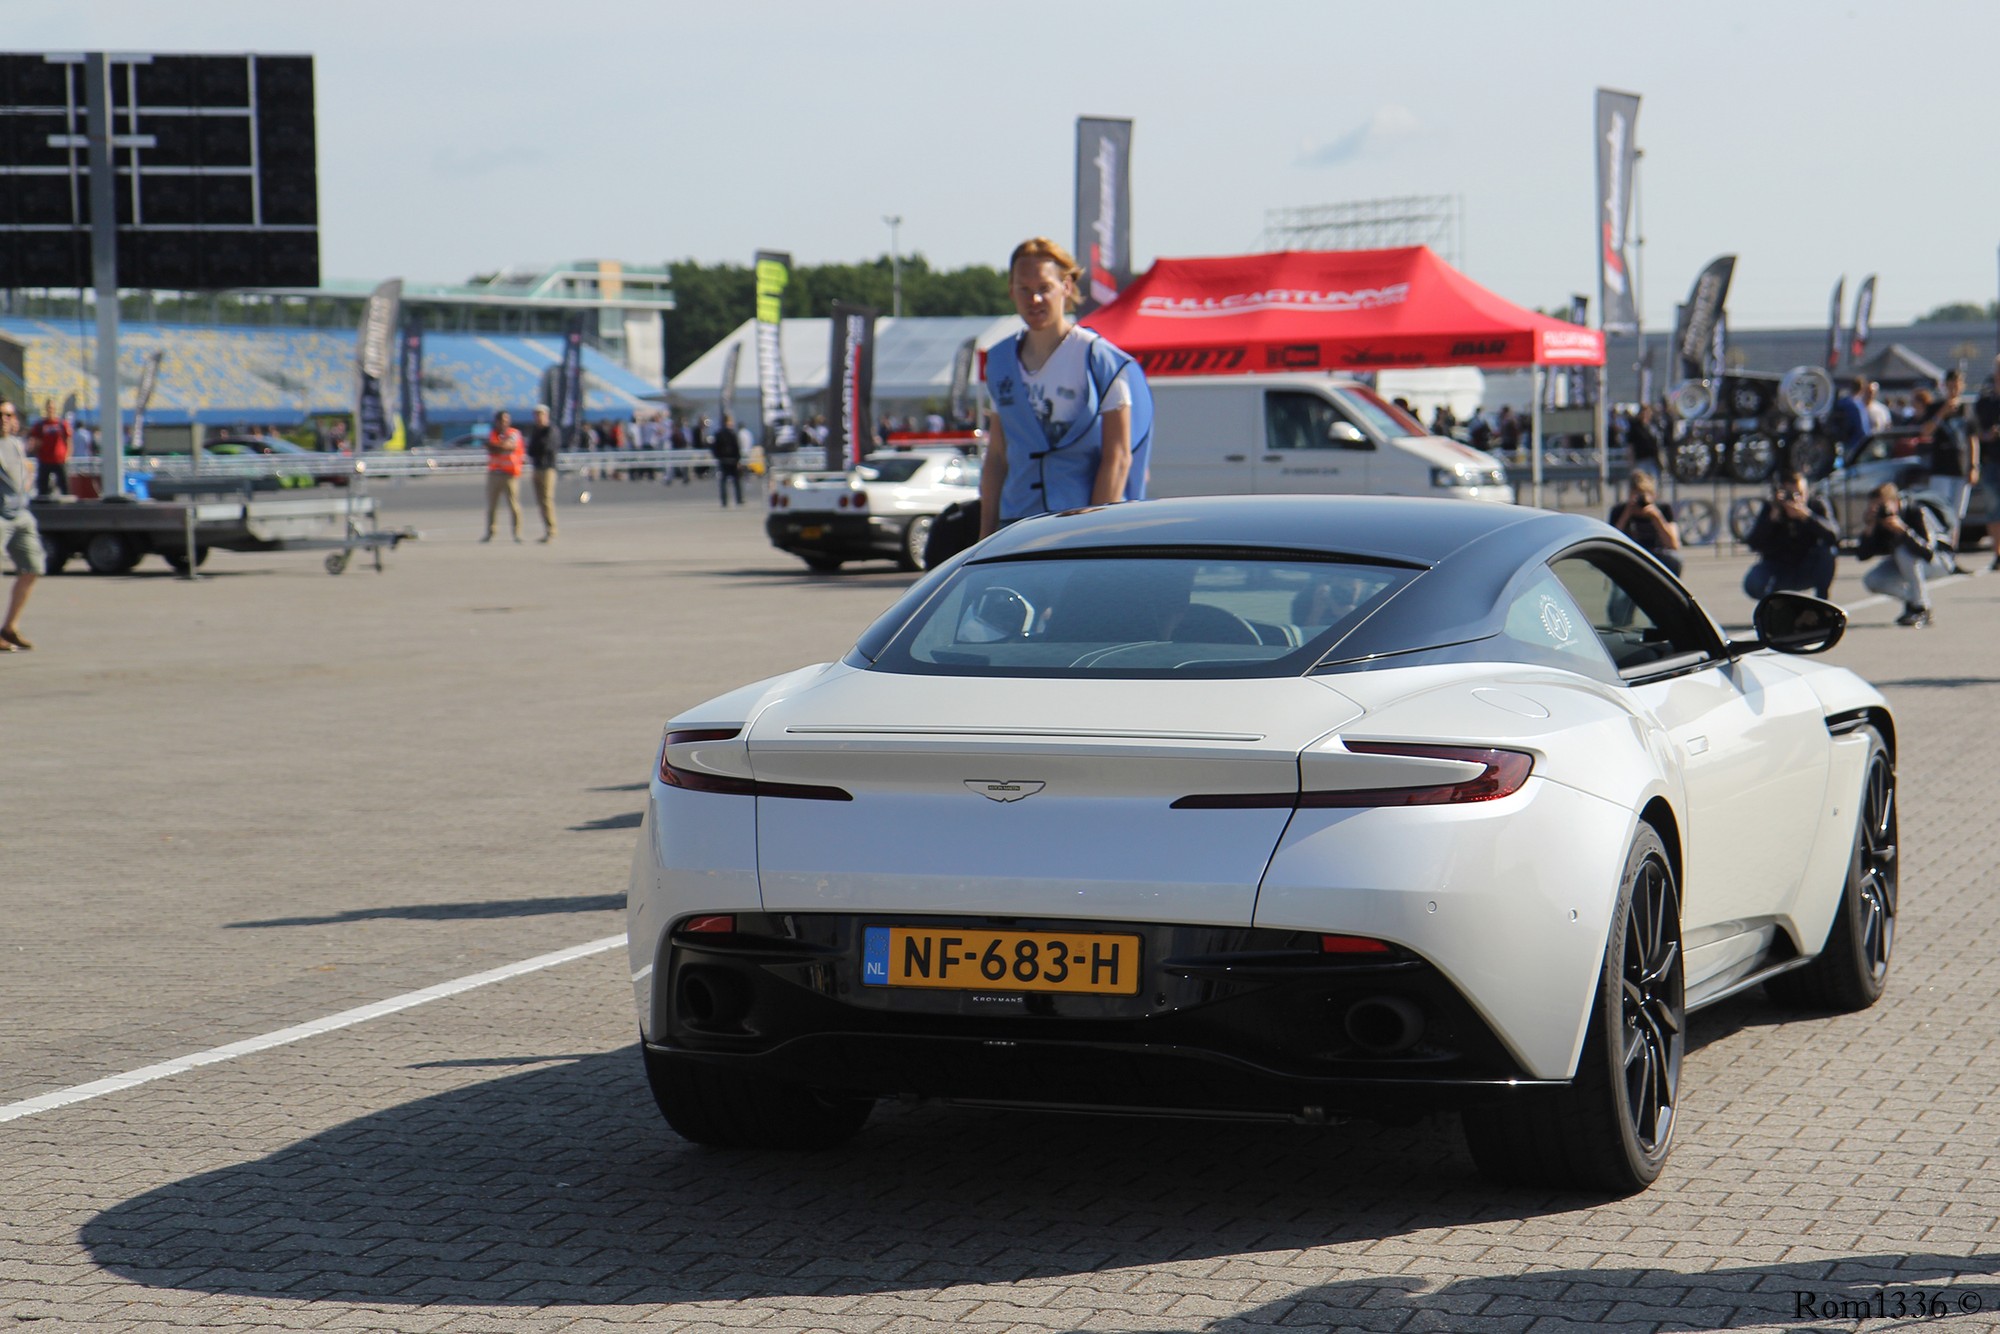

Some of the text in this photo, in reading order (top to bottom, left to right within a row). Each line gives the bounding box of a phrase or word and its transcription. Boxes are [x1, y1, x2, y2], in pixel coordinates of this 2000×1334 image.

[1139, 282, 1410, 311] FULLCARTUNING
[868, 936, 1119, 985] NL NF-683-H
